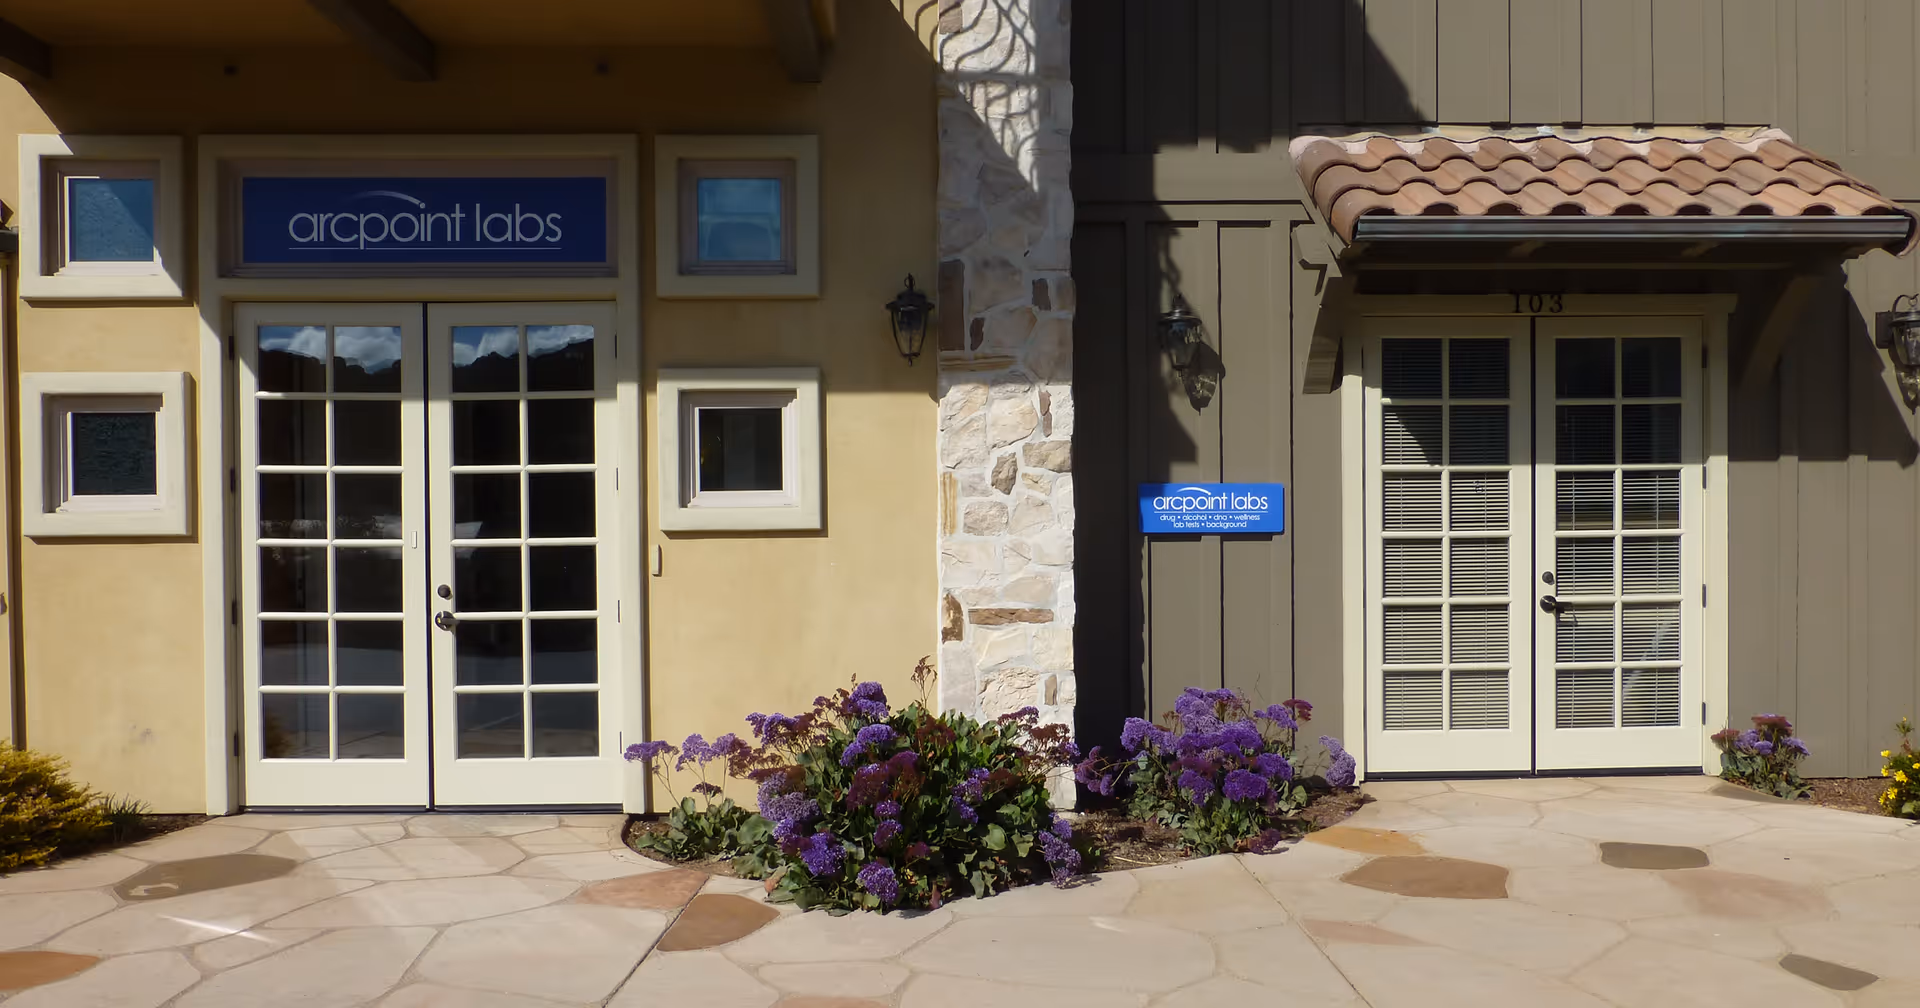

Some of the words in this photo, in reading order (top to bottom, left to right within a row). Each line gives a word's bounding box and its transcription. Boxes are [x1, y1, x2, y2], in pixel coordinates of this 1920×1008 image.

[288, 202, 466, 250] arcpoint
[475, 202, 563, 243] labs
[1511, 292, 1563, 313] 103
[1153, 492, 1228, 512] arcpoint
[1231, 492, 1269, 510] labs
[1159, 513, 1176, 522] drug
[1182, 513, 1207, 521] alcohol
[1213, 513, 1227, 521] dna
[1233, 513, 1260, 521] wellness
[1206, 521, 1247, 529] background
